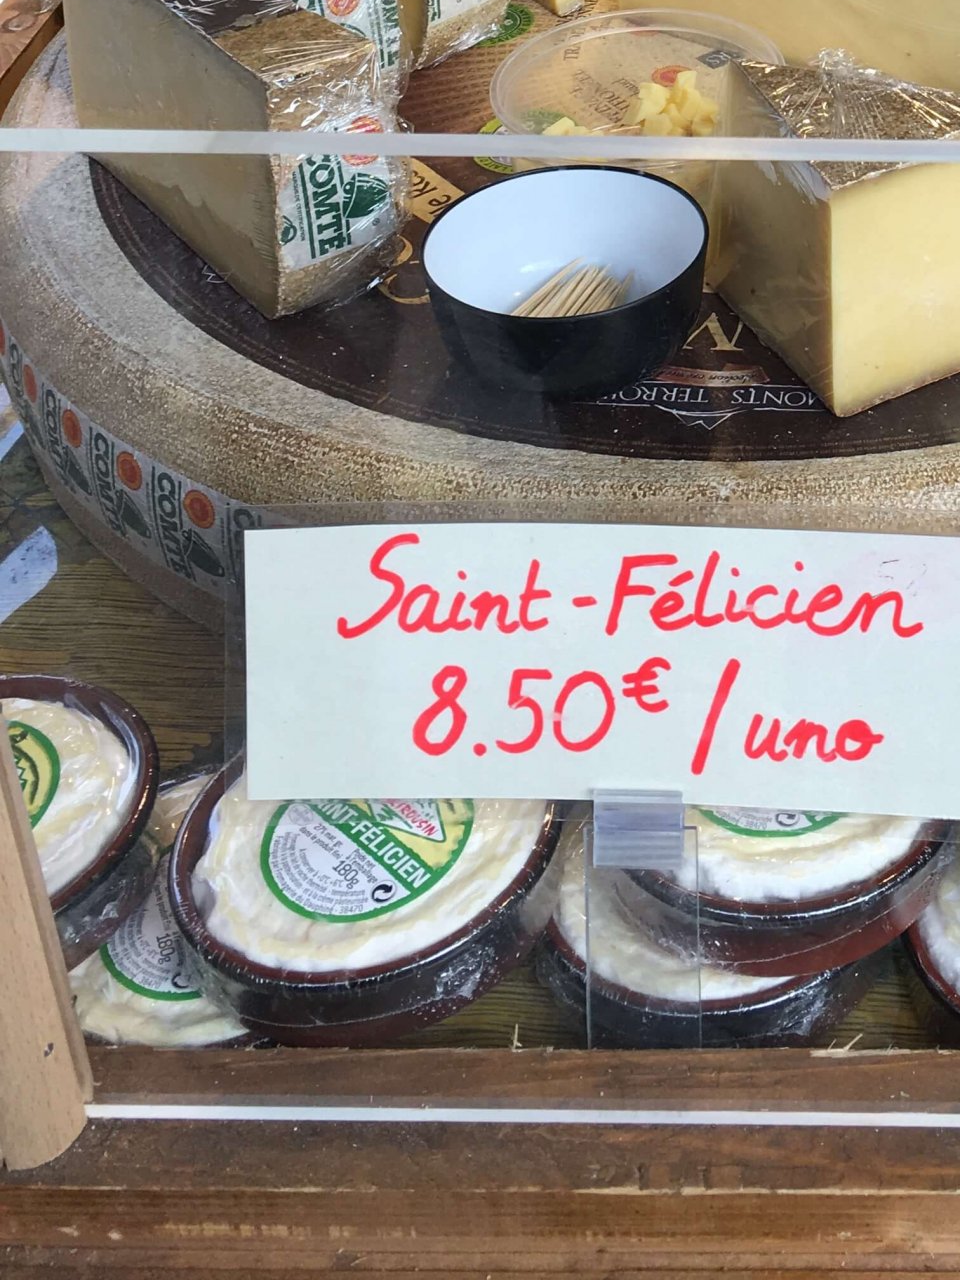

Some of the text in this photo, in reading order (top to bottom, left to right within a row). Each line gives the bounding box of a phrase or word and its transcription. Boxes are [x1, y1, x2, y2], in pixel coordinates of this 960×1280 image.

[412, 657, 669, 756] 8.50€
[332, 861, 359, 890] 180g
[155, 933, 173, 967] 180g
